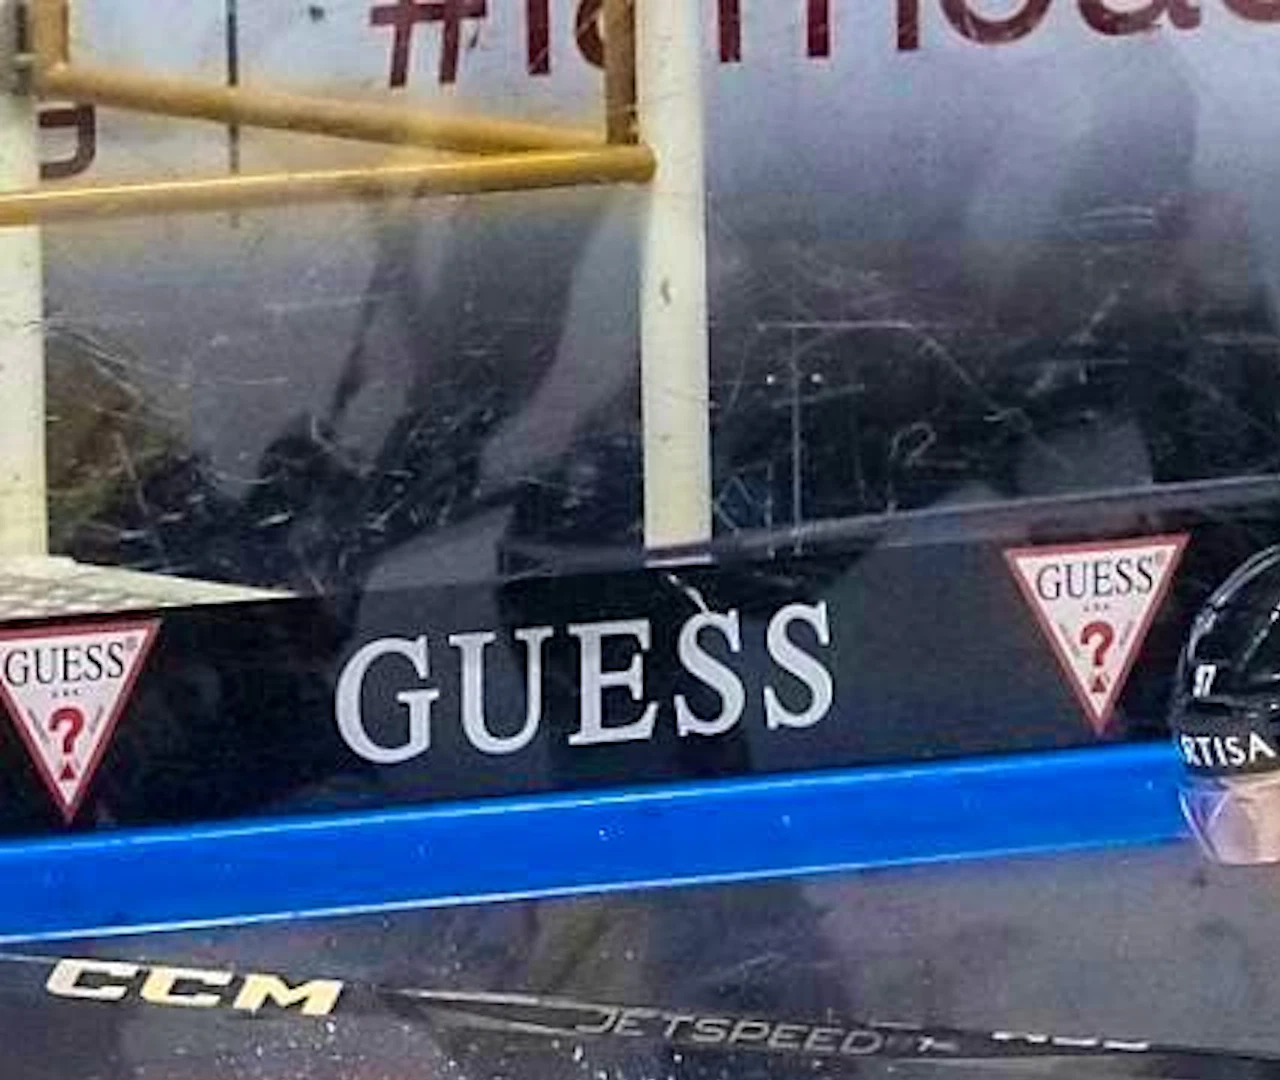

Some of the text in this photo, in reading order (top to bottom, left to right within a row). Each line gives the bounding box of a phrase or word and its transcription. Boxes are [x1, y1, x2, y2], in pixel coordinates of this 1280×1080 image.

[1035, 553, 1154, 601] GUESS
[4, 641, 125, 687] GUESS
[335, 601, 834, 765] GUESS
[1178, 731, 1277, 767] RTISA
[44, 958, 343, 1016] CCM
[575, 1005, 886, 1057] JETSPEED
